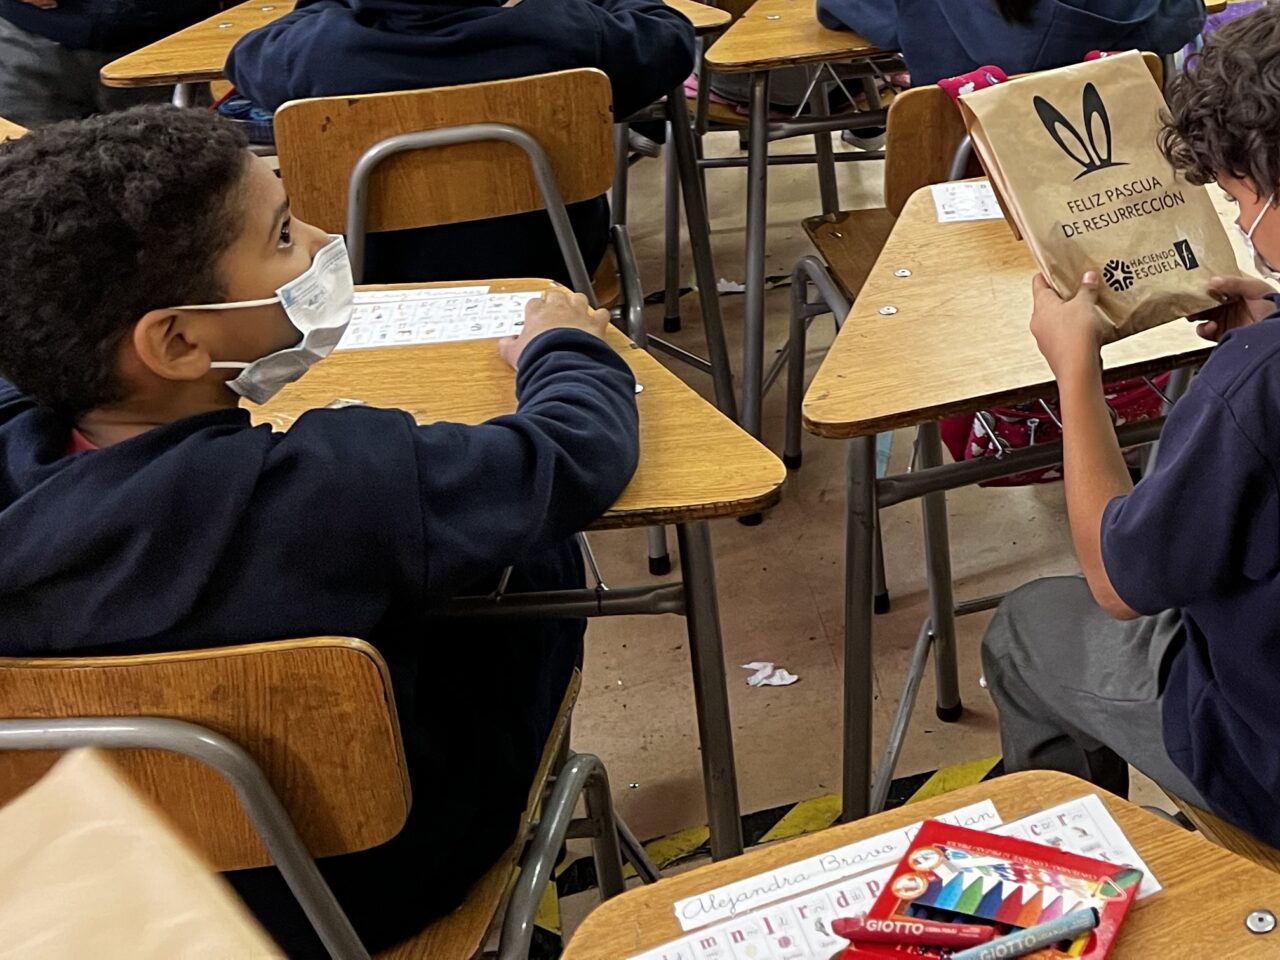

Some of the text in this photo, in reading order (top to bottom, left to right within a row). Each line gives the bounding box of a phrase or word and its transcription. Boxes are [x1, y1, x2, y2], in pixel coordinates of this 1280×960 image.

[1066, 176, 1163, 215] FELIZ PASCUA
[1062, 190, 1186, 238] DE RESURRECCIÓN
[1129, 248, 1176, 269] HACIENDO
[1134, 260, 1182, 280] ESCUELA
[682, 873, 811, 919] Alejandra
[818, 843, 897, 874] Bravo
[865, 880, 880, 897] p
[836, 890, 850, 908] d
[798, 904, 808, 919] r
[731, 929, 746, 944] n
[866, 920, 925, 935] GIOTTO
[700, 936, 718, 950] m
[979, 934, 1037, 960] GIOTTO
